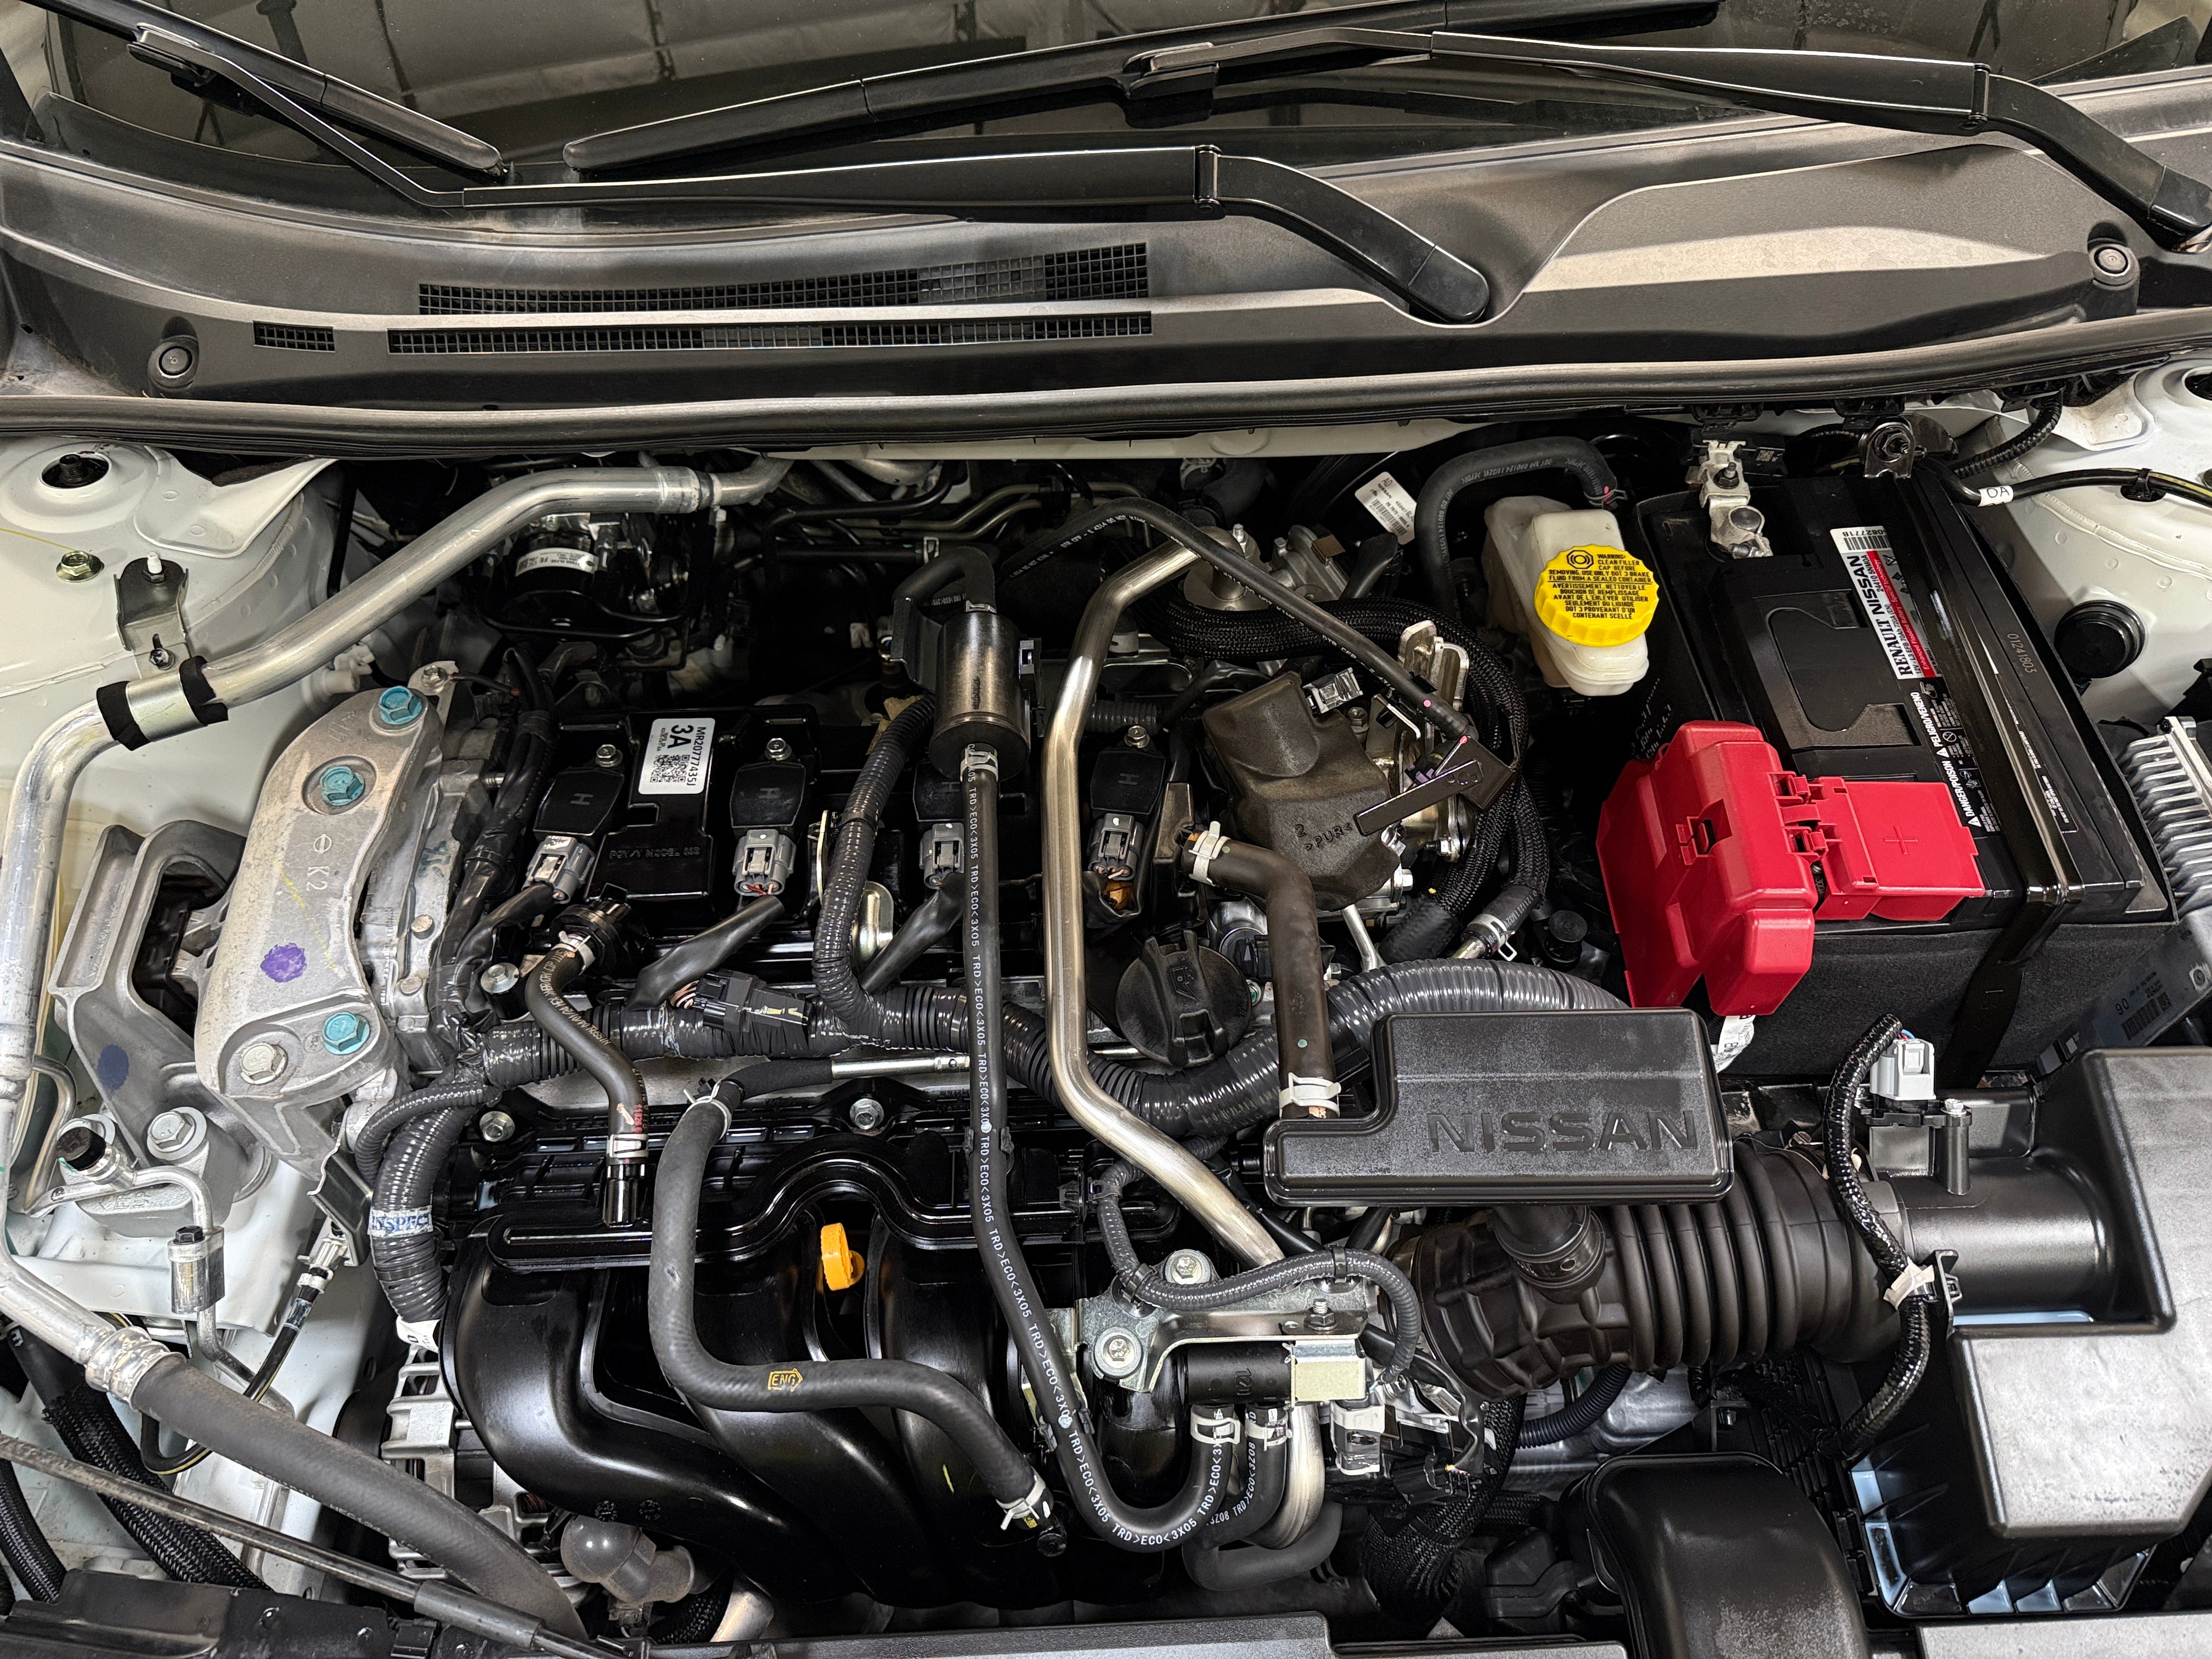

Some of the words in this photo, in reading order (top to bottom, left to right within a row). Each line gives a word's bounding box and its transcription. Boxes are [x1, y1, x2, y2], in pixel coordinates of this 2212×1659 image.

[1847, 555, 1884, 615] NISSAN
[1870, 575, 1884, 592] 24410
[1874, 558, 1888, 585] technology
[1884, 585, 1898, 603] Special
[1897, 606, 1907, 624] Battery
[1906, 624, 1918, 644] Flooded
[1875, 619, 1914, 676] RENAULT
[1915, 645, 1929, 670] Enhanced
[2007, 634, 2038, 673] 01241803
[667, 725, 694, 749] 3A
[1911, 692, 1943, 747] PELIGRO/VENENO
[687, 727, 707, 786] MR20777435J
[1942, 760, 1975, 817] DANGER/POISON
[968, 787, 978, 860] TRD>ECO<3X05
[970, 864, 980, 947] TRD>ECO<3X05
[972, 954, 986, 1046] TRD>ECO<3X05
[1426, 1110, 1699, 1153] NISSAN
[980, 1135, 995, 1223] TRD>ECO<3X05
[989, 1228, 1032, 1318] TRD>ECO<3X05
[1068, 1429, 1111, 1523] TRD>ECO<3X05
[1111, 1517, 1197, 1546] TRD>ECO<3X05
